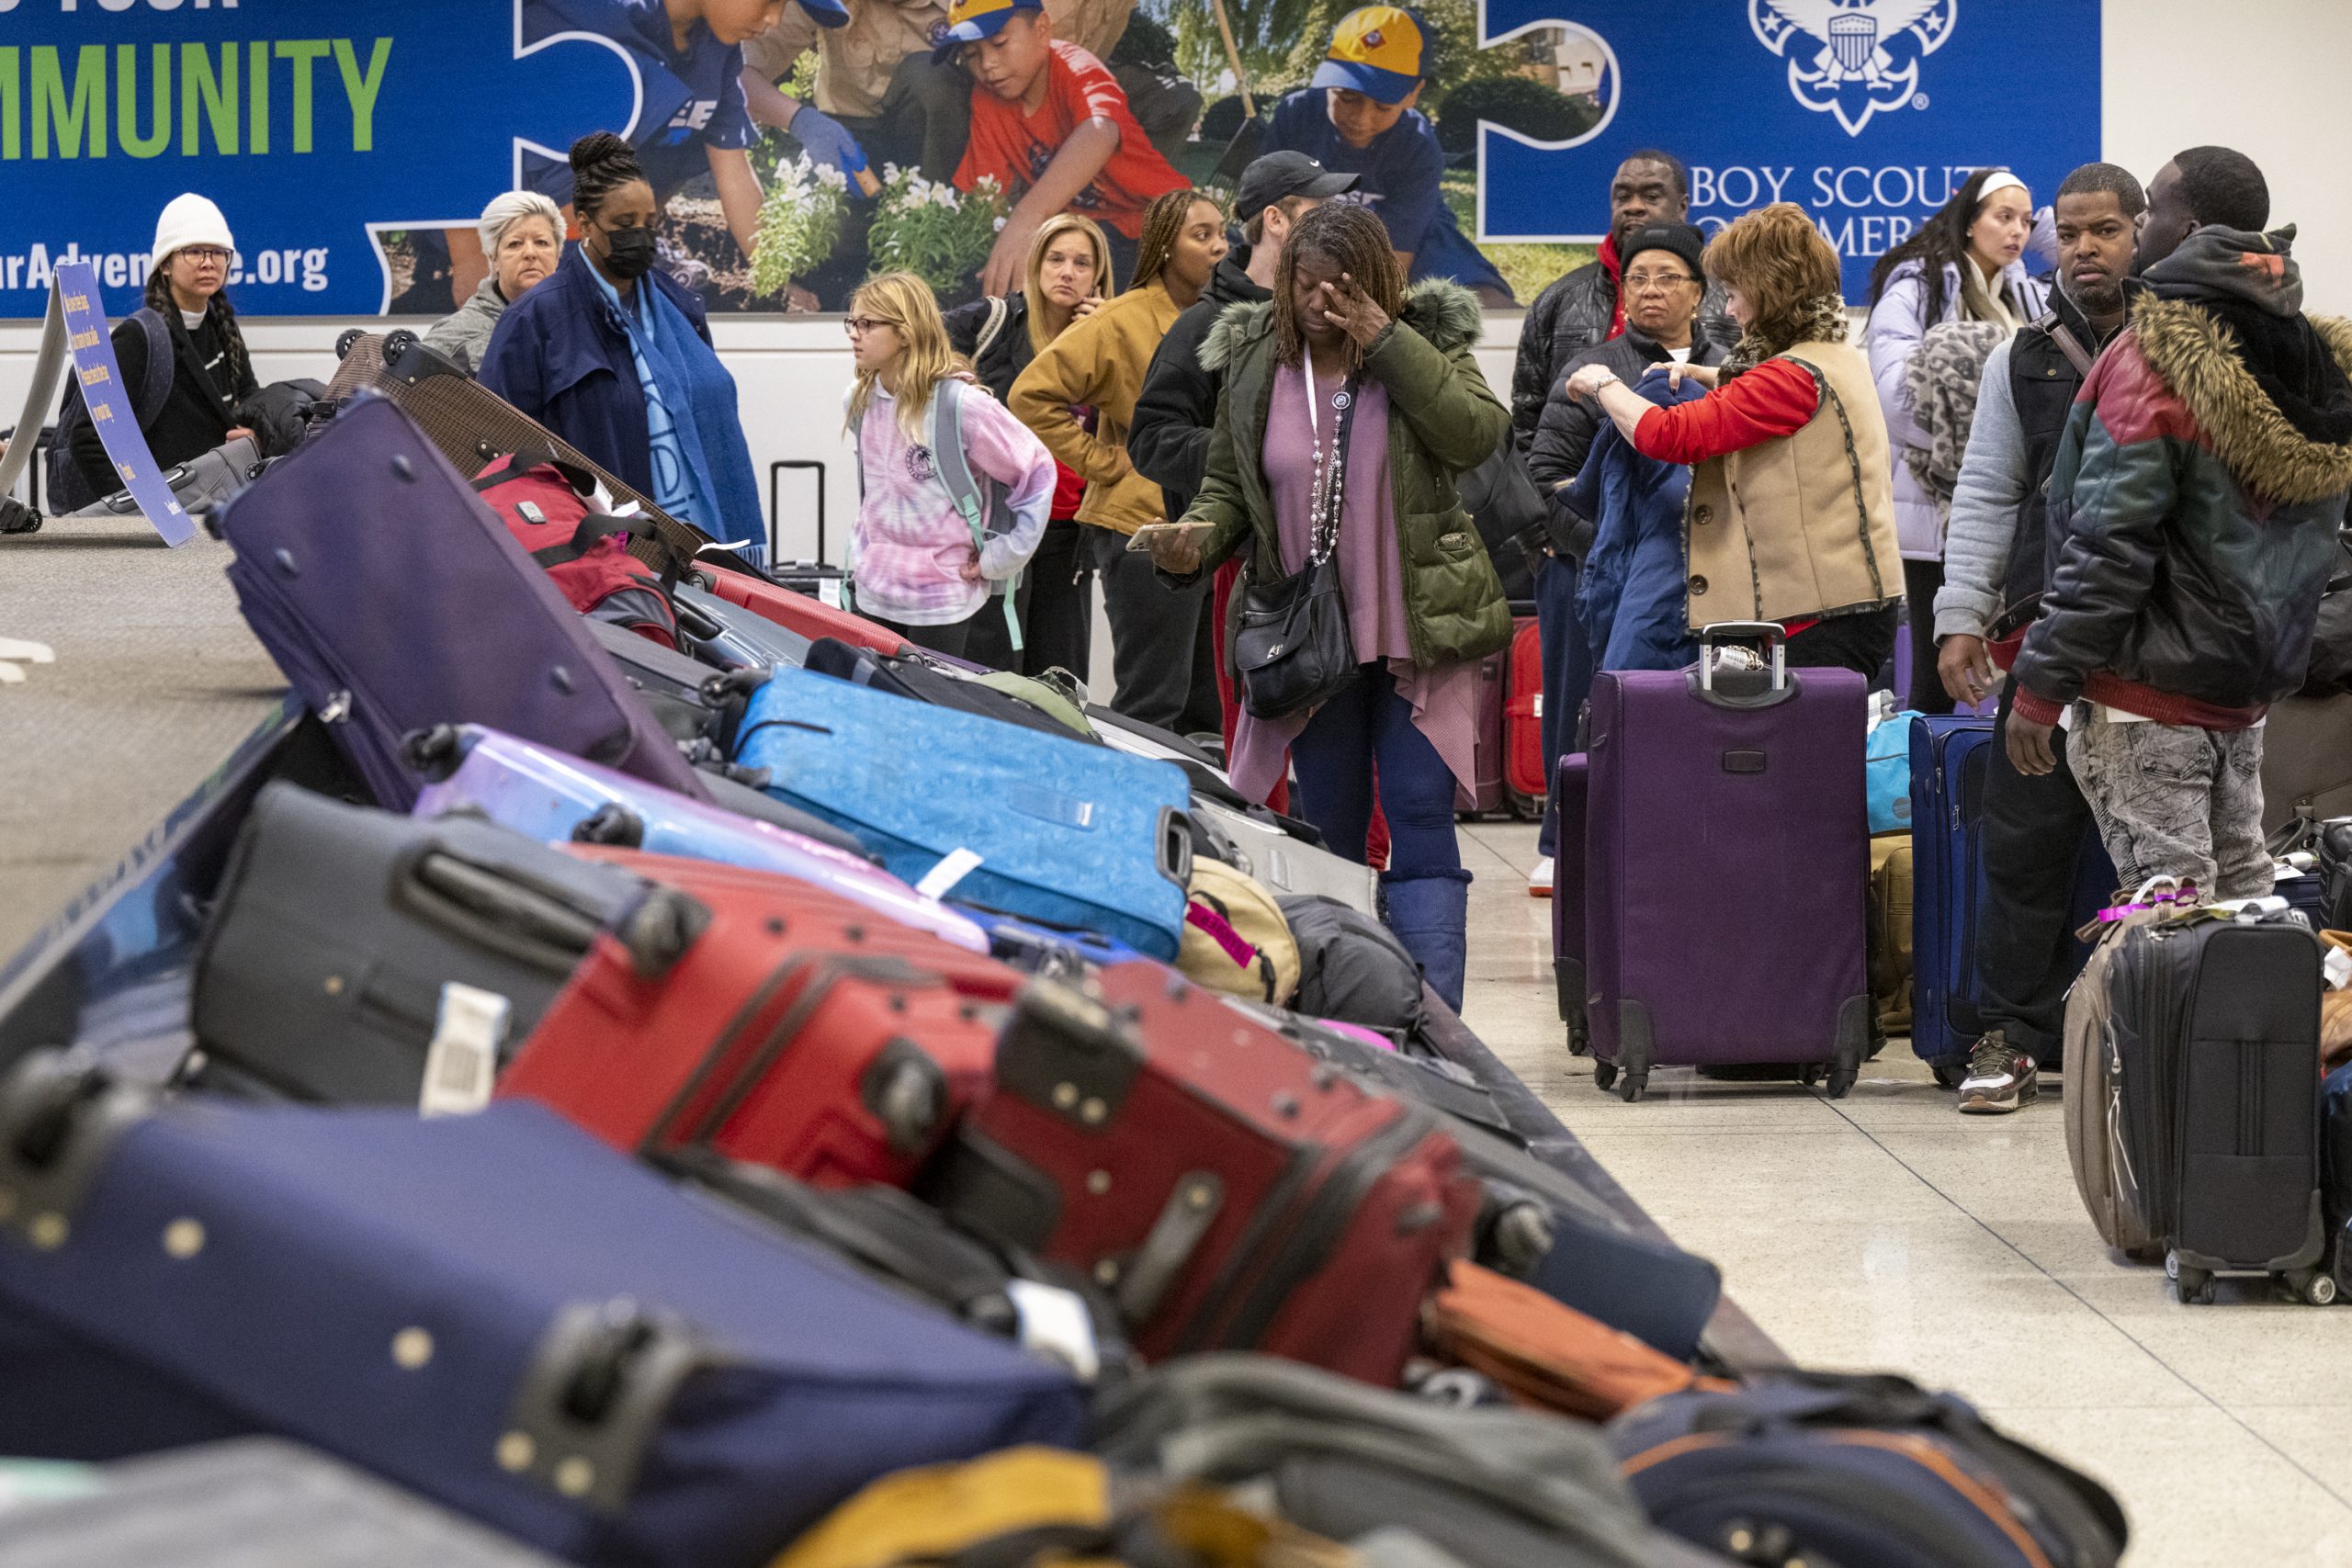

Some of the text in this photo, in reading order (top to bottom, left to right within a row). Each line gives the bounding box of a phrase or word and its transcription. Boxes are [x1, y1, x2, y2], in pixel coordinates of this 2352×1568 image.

[0, 37, 393, 161] MUNITY
[1690, 166, 2011, 208] BOY SCOU
